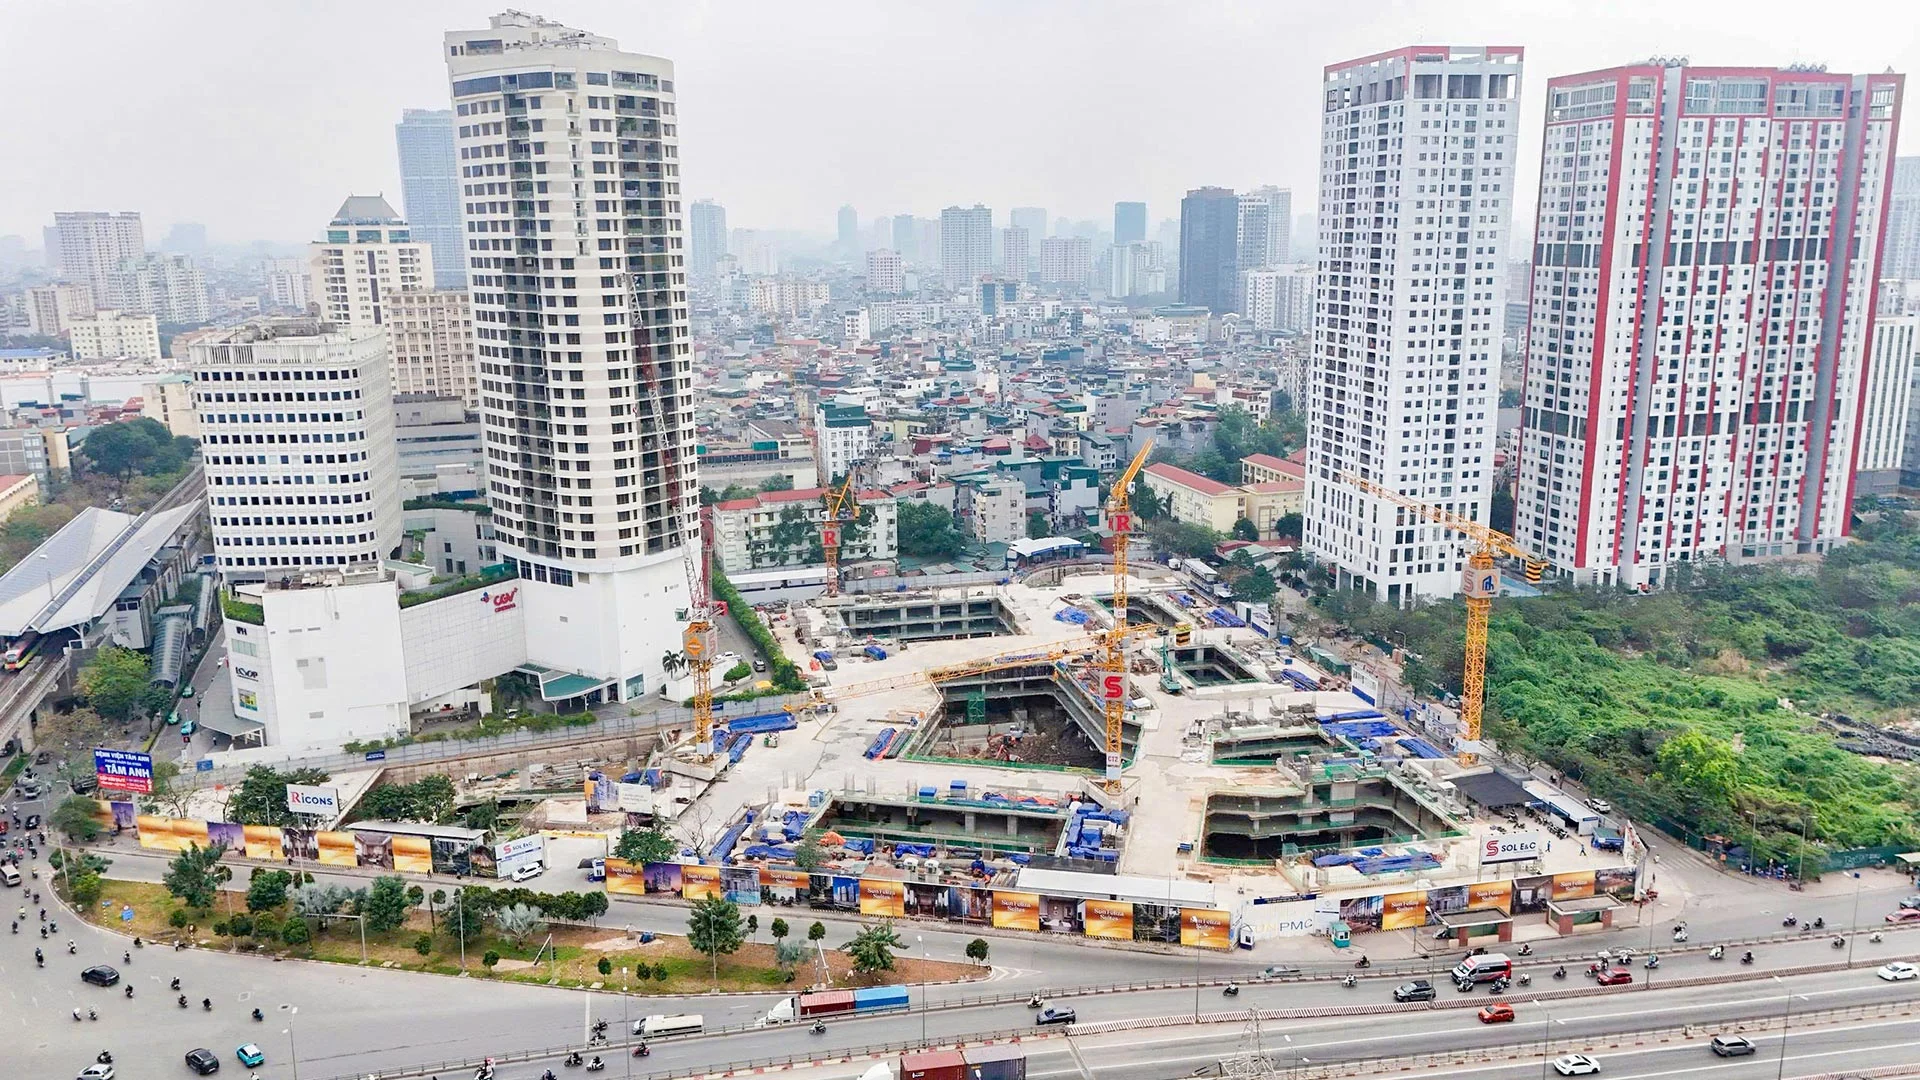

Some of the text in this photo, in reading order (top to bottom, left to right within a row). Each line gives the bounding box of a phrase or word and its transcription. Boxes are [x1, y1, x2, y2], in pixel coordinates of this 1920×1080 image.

[1115, 515, 1131, 532] R
[823, 530, 838, 545] R
[493, 589, 516, 606] CGV
[1104, 676, 1123, 698] S
[105, 764, 150, 778] TÂM ANH
[1501, 844, 1517, 852] SOL
[1520, 842, 1536, 850] E&C
